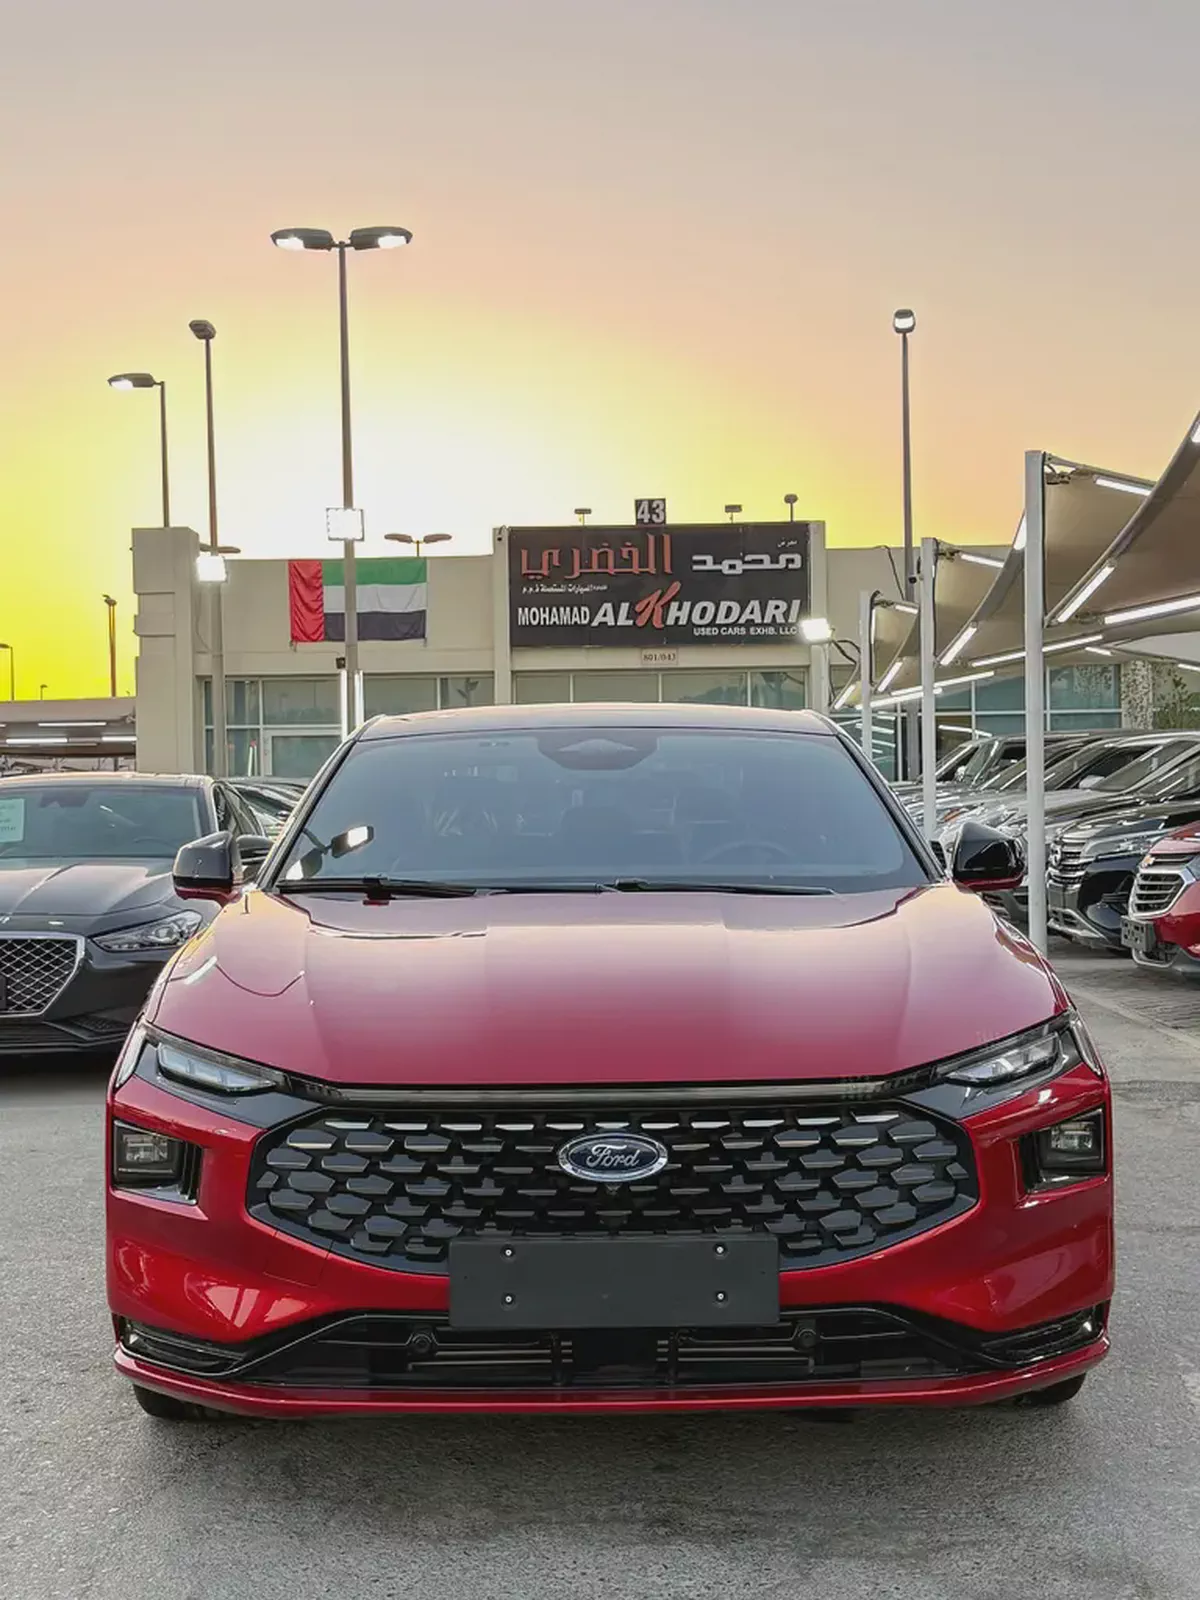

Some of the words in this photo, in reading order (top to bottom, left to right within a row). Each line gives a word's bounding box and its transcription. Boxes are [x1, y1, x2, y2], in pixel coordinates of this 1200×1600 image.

[636, 500, 665, 523] 43
[520, 533, 673, 580] الخضري
[691, 553, 802, 575] محمد
[517, 606, 590, 626] MOHAMAD
[693, 627, 719, 636] USED
[720, 627, 746, 636] CARS
[779, 626, 797, 635] LLC
[586, 1144, 641, 1167] Ford
